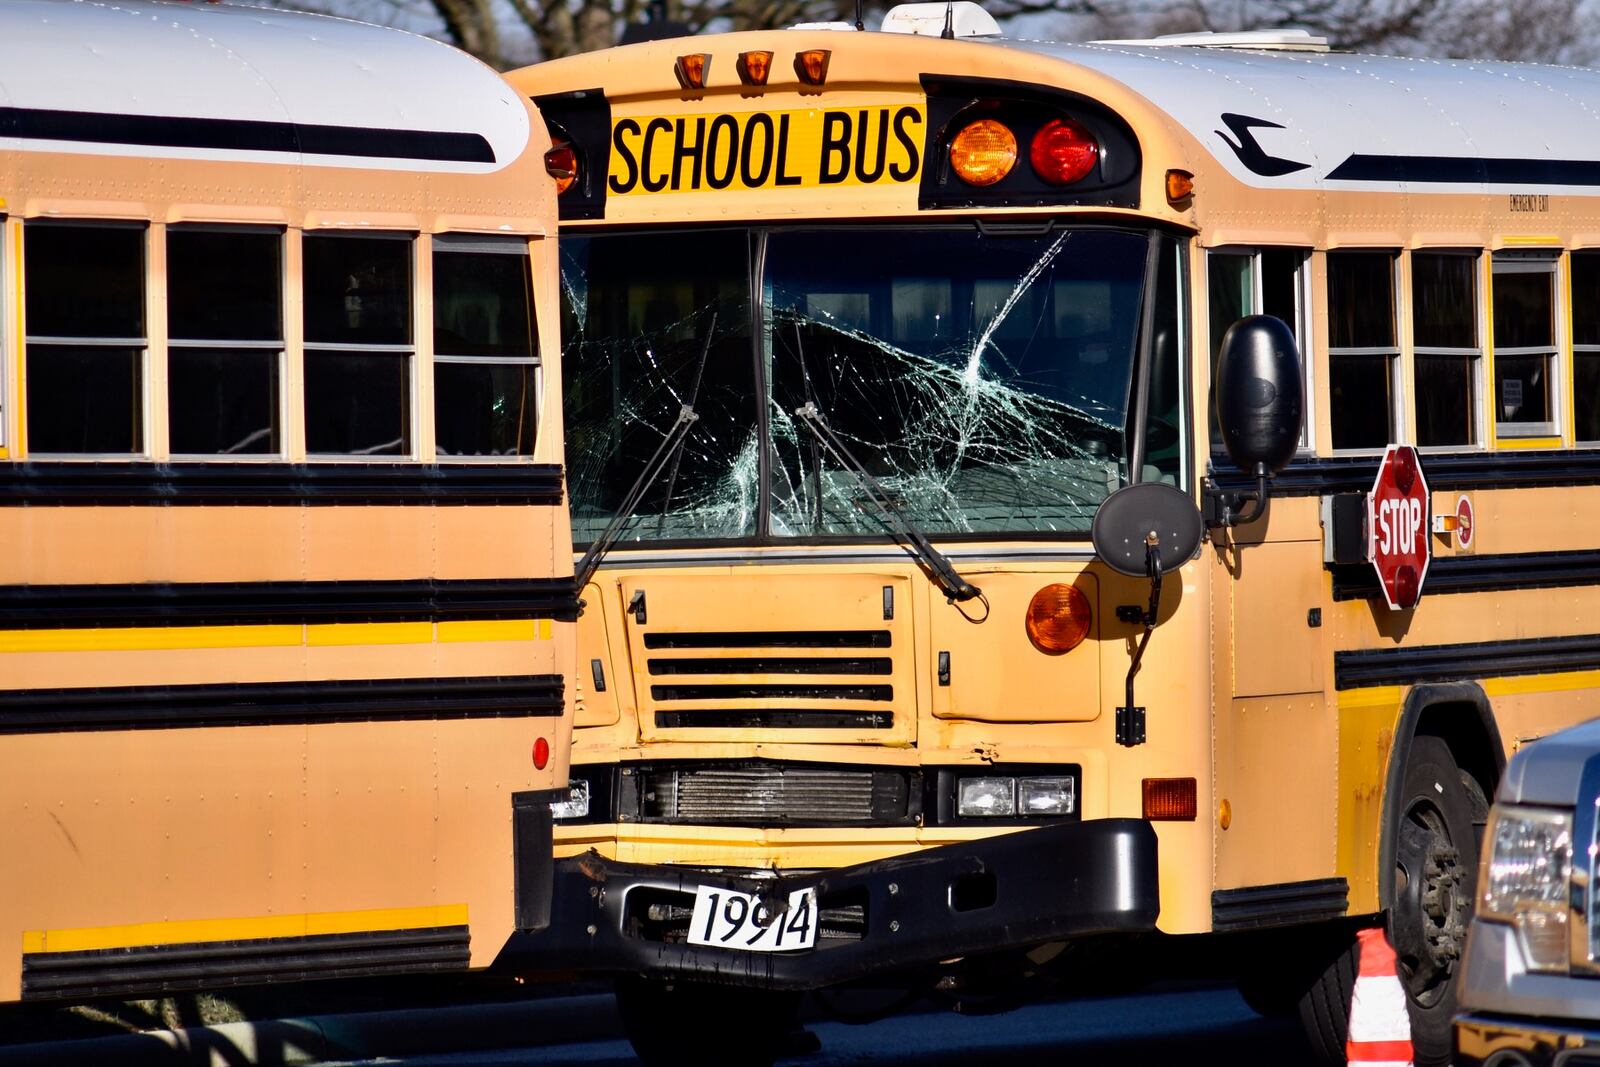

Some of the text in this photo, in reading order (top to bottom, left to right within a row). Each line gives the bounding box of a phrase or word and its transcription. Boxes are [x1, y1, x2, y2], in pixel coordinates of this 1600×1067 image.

[608, 106, 922, 194] SCHOOL BUS
[1510, 194, 1549, 212] EMERGENCY EXIT
[1380, 498, 1421, 556] STOP
